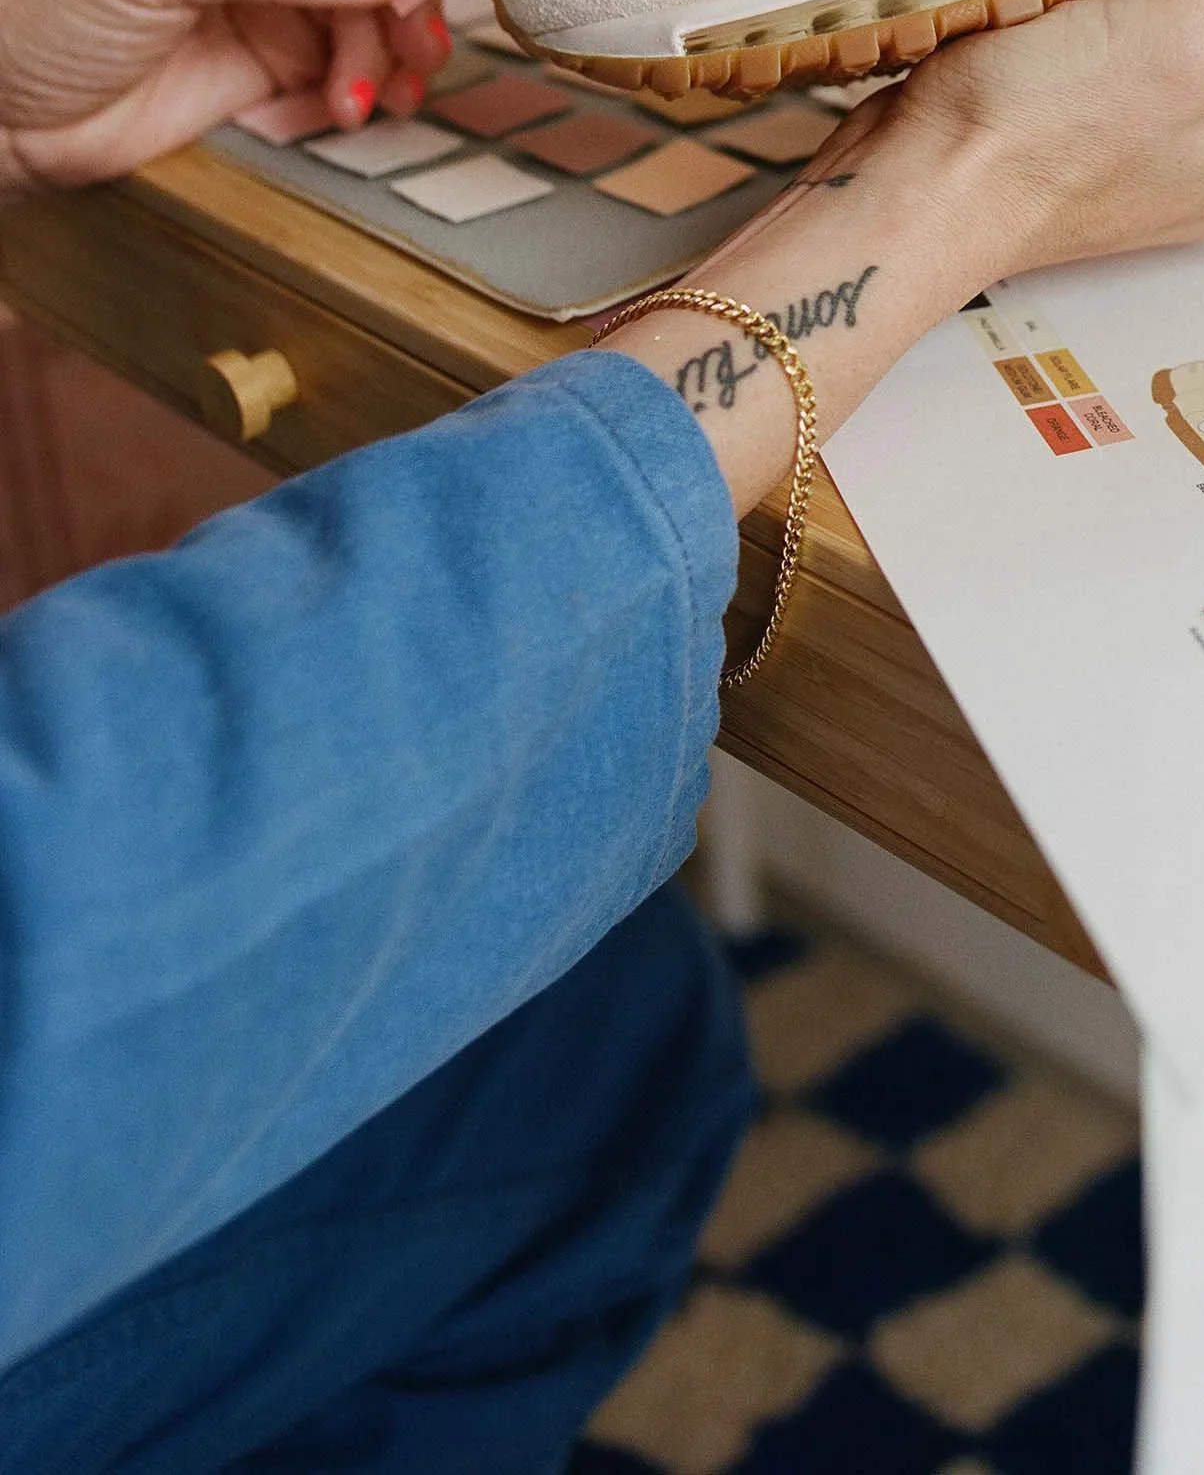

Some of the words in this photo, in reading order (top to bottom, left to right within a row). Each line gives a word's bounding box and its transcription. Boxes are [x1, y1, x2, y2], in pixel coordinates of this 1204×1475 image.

[1046, 417, 1070, 442] ORANGE
[1083, 412, 1104, 432] CORAL
[1091, 404, 1120, 433] BLEACHED
